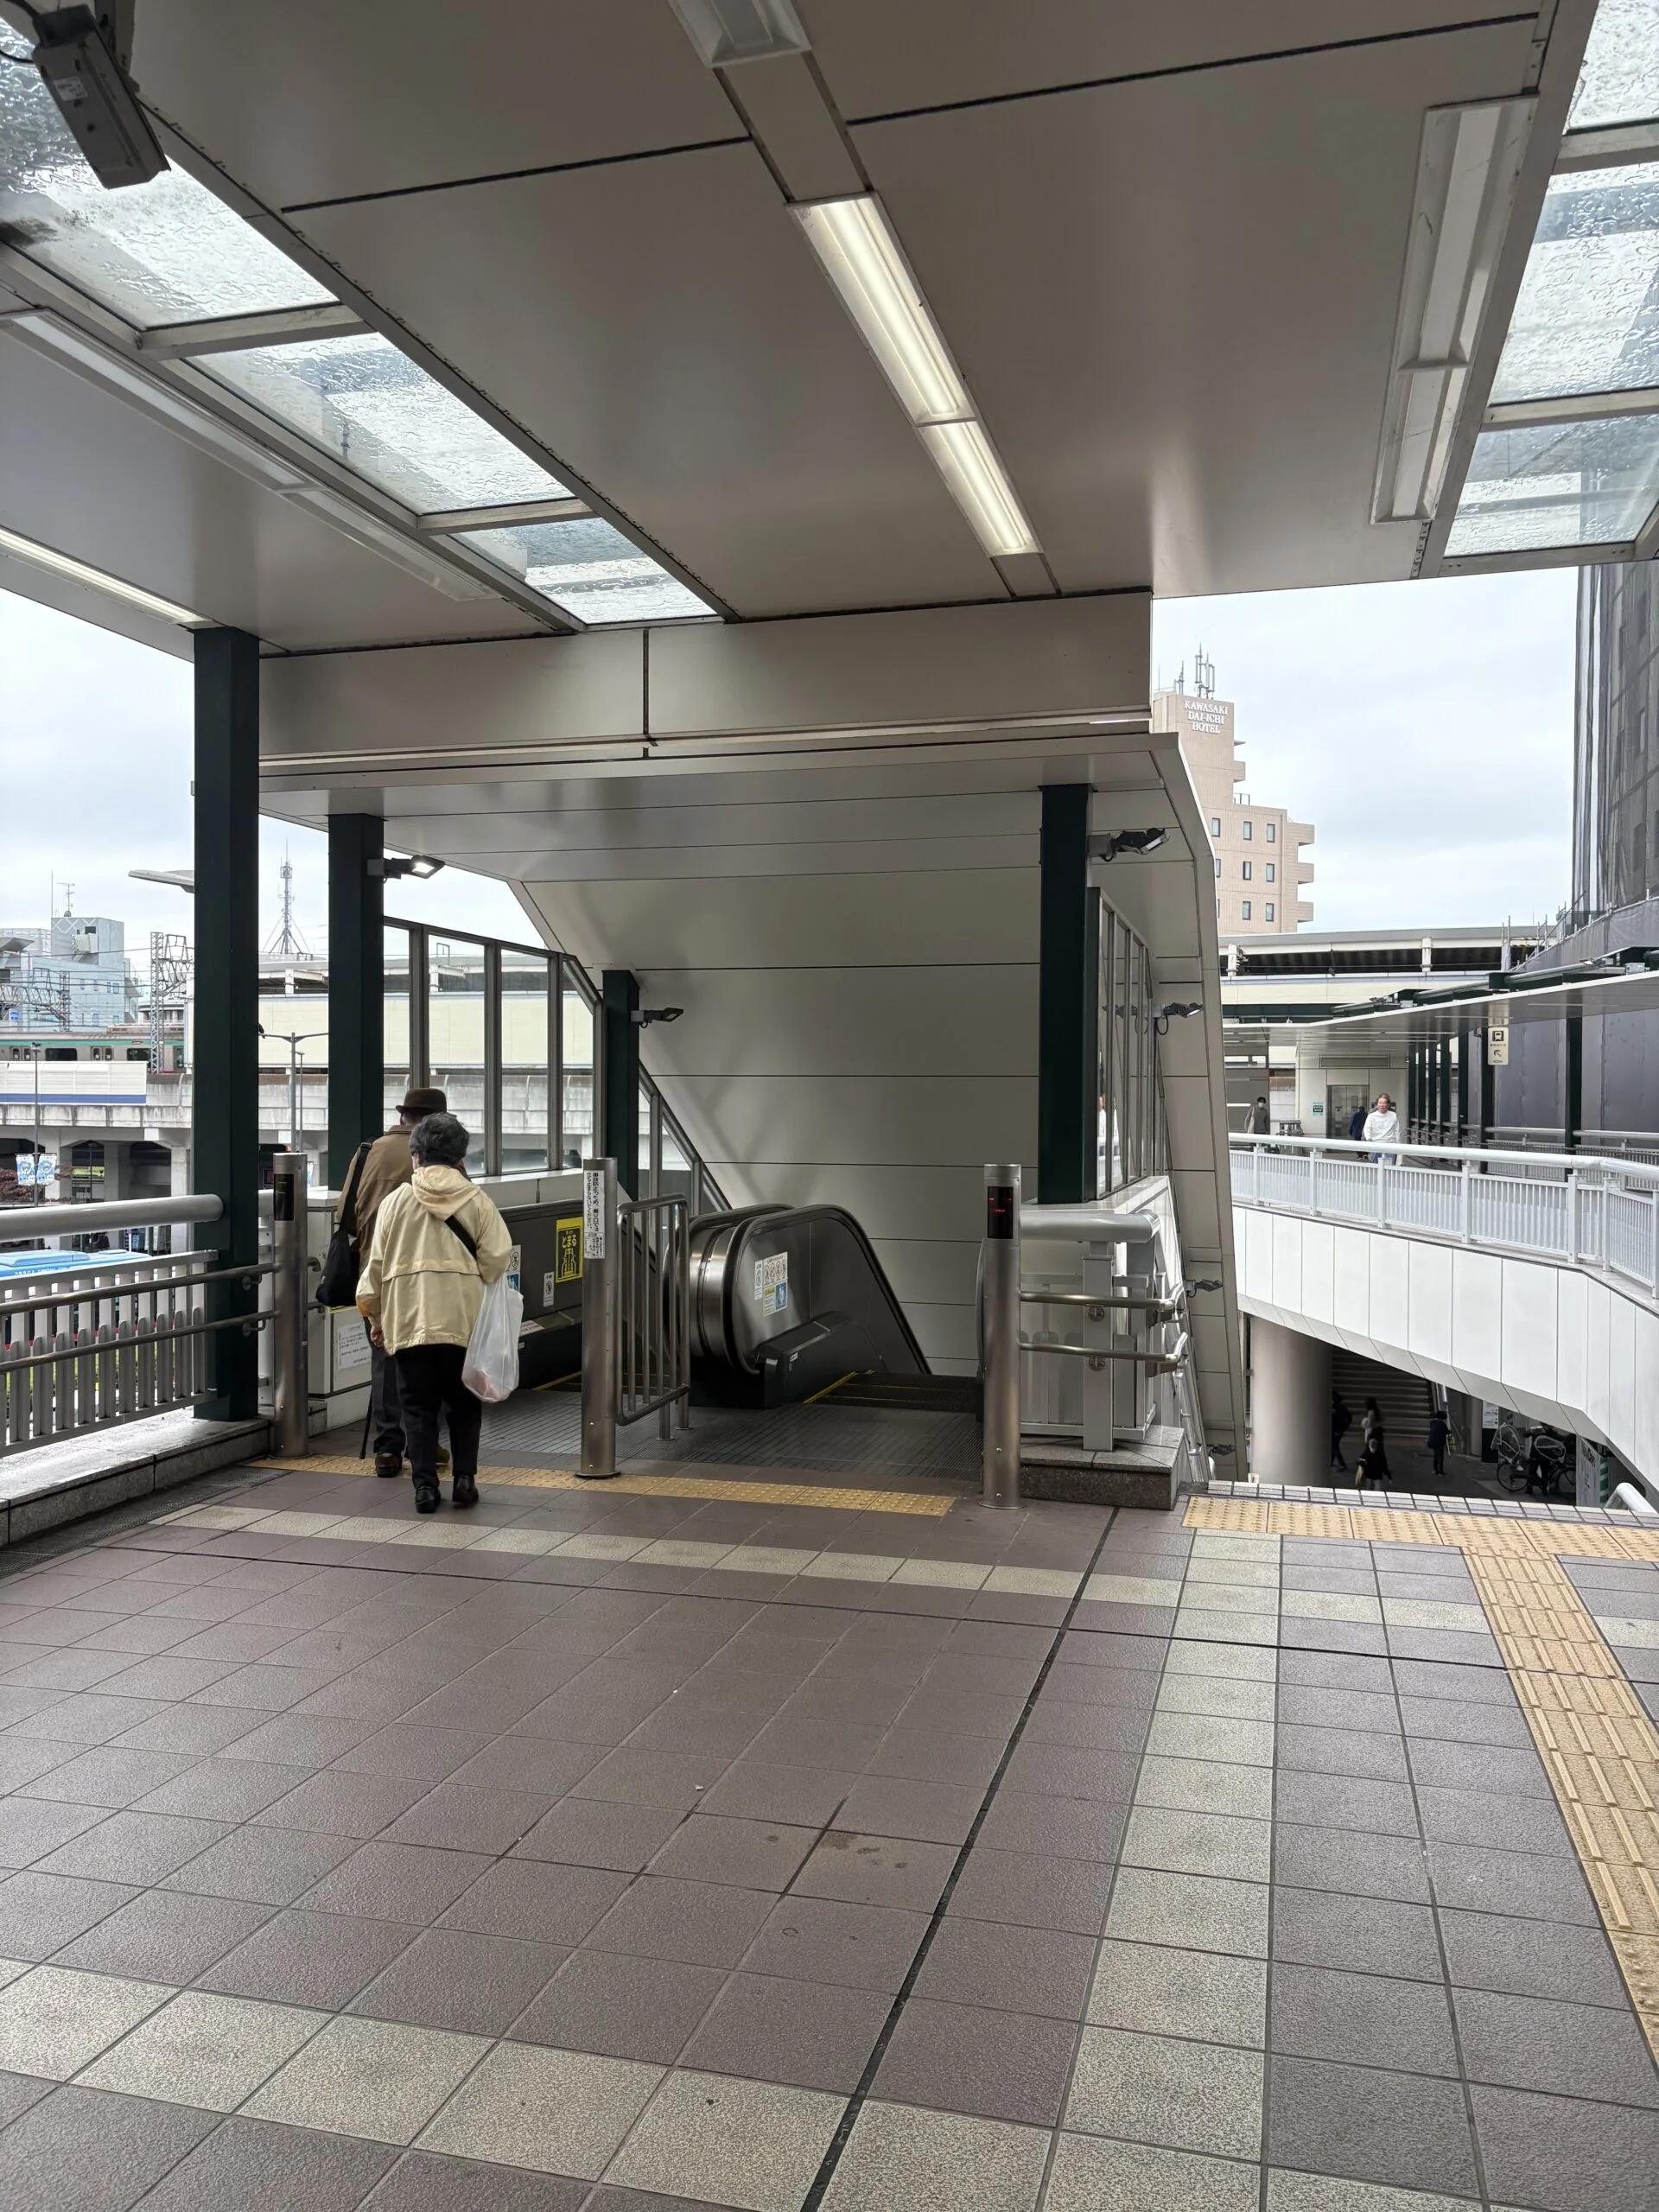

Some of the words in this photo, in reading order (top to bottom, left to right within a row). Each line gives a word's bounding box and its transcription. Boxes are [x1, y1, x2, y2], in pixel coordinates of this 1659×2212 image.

[1184, 700, 1228, 715] KAWASAKI
[1188, 711, 1224, 724] DAI-ICHI
[1192, 721, 1220, 734] HOTEL
